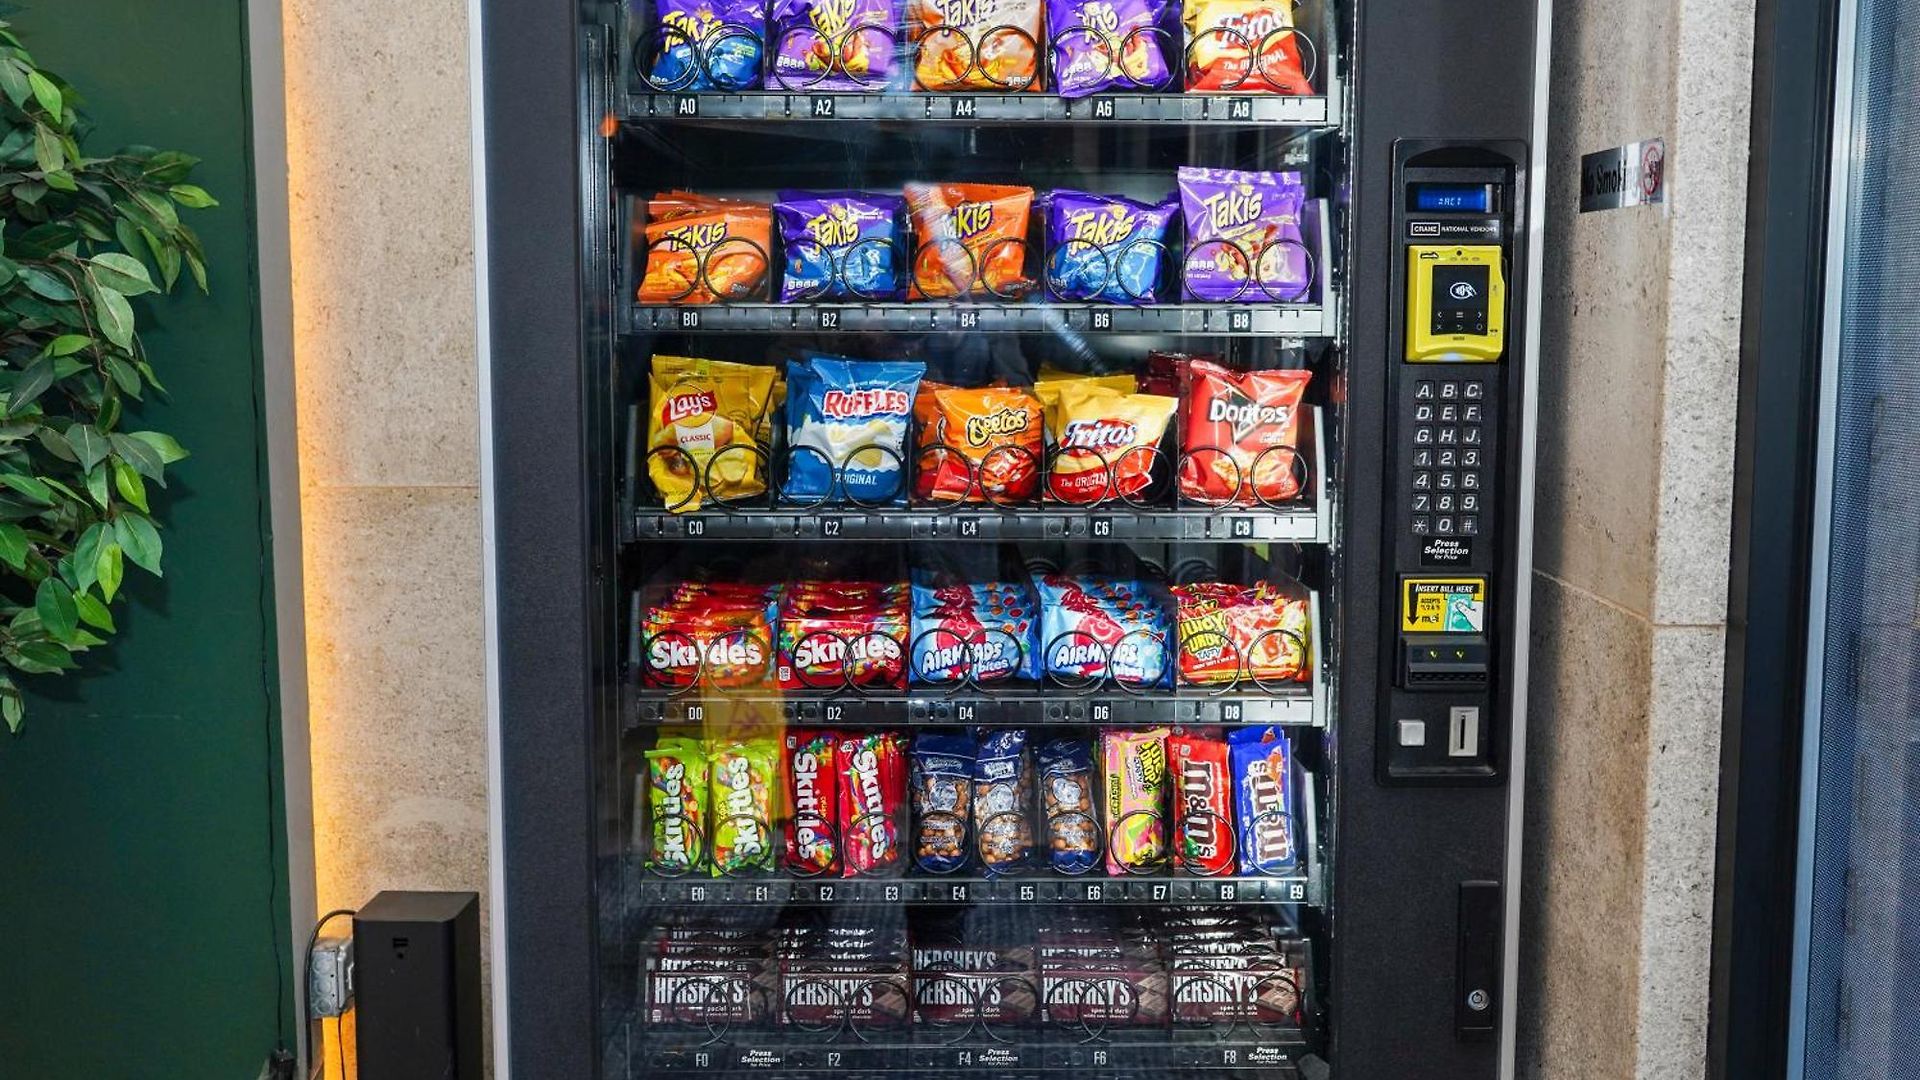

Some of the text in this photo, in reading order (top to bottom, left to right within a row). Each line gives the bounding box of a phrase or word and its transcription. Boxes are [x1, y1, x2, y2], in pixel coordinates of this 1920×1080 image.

[680, 98, 696, 115] A0
[816, 99, 832, 115] A2
[956, 103, 972, 116] A4
[1096, 103, 1112, 117] A6
[1233, 103, 1249, 117] A8
[1202, 184, 1263, 236] Takis
[684, 311, 697, 326] B0
[823, 312, 837, 327] B2
[962, 313, 976, 328] B4
[1095, 313, 1109, 328] B6
[1234, 313, 1249, 328] B8
[1420, 385, 1478, 397] A B C
[669, 392, 711, 421] Lay's
[822, 389, 909, 420] RUFFLES
[1209, 398, 1289, 426] Doritos
[1417, 407, 1477, 420] D E F
[680, 433, 711, 444] CLASSIC
[1060, 419, 1137, 448] Fritos
[1417, 430, 1476, 442] G H J
[1420, 452, 1476, 464] 1 2 3
[1417, 474, 1475, 487] 4 5 6
[1418, 497, 1475, 509] 7 8 9
[688, 521, 704, 535] C0
[824, 521, 840, 535] C2
[962, 521, 977, 535] C4
[1095, 521, 1109, 535] C6
[1235, 520, 1250, 535] C8
[1424, 546, 1469, 555] Selection
[1416, 584, 1439, 593] INSERT
[688, 707, 702, 720] D0
[827, 707, 841, 720] D2
[960, 706, 973, 720] D4
[1094, 706, 1108, 720] D6
[1225, 706, 1239, 719] D8
[794, 752, 820, 859] Skittles
[1183, 760, 1215, 858] m&m's
[692, 887, 704, 900] E0
[756, 887, 767, 900] E1
[821, 887, 833, 899] E2
[886, 887, 898, 899] E3
[953, 886, 965, 899] E4
[1021, 887, 1033, 899] E5
[1088, 887, 1100, 899] E6
[1153, 886, 1166, 899] E7
[1221, 886, 1233, 899] E8
[1290, 886, 1303, 899] E9
[696, 1053, 709, 1066] F0
[829, 1053, 841, 1066] F2
[959, 1052, 971, 1065] F4
[1094, 1052, 1107, 1065] F6
[1225, 1051, 1237, 1064] F8
